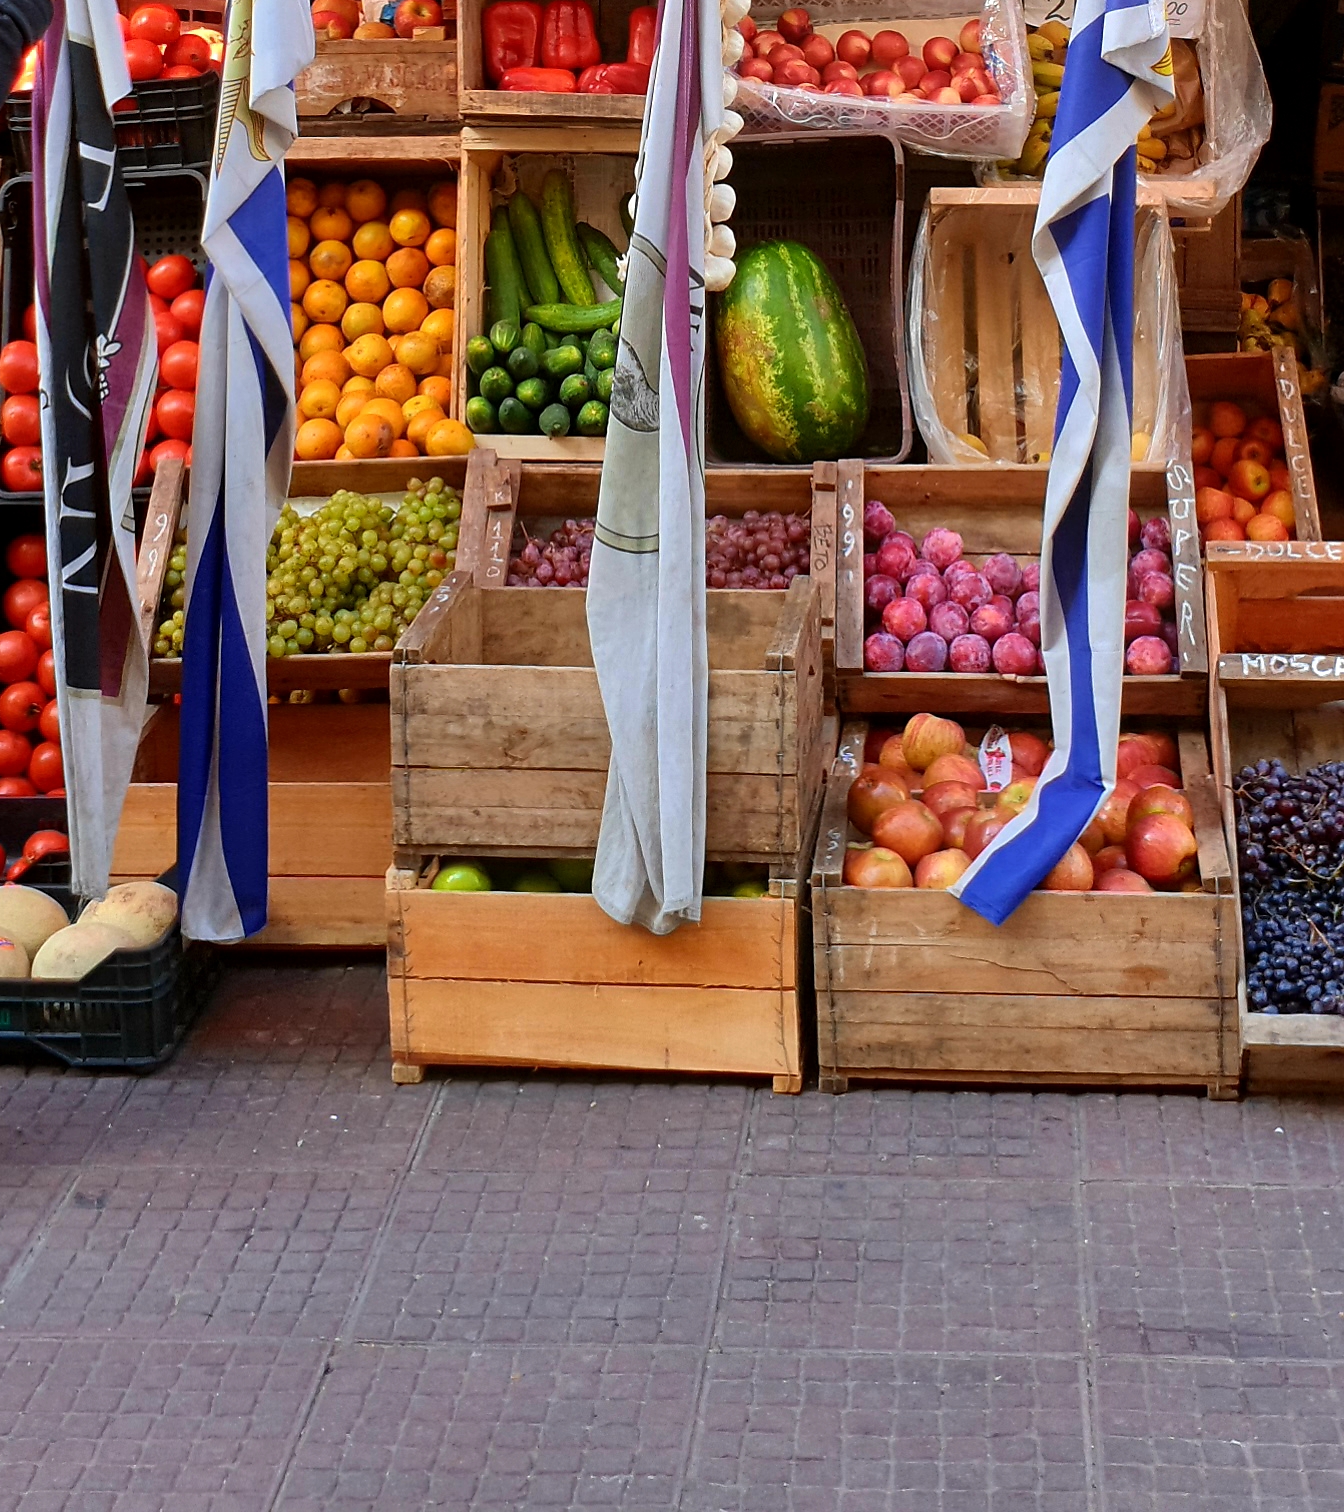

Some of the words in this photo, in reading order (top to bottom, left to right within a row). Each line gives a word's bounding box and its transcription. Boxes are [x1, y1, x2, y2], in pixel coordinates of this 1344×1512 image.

[1279, 378, 1312, 499] DULCE
[843, 503, 855, 558] 99
[1166, 463, 1197, 646] SUPER
[1245, 542, 1343, 560] DULCE
